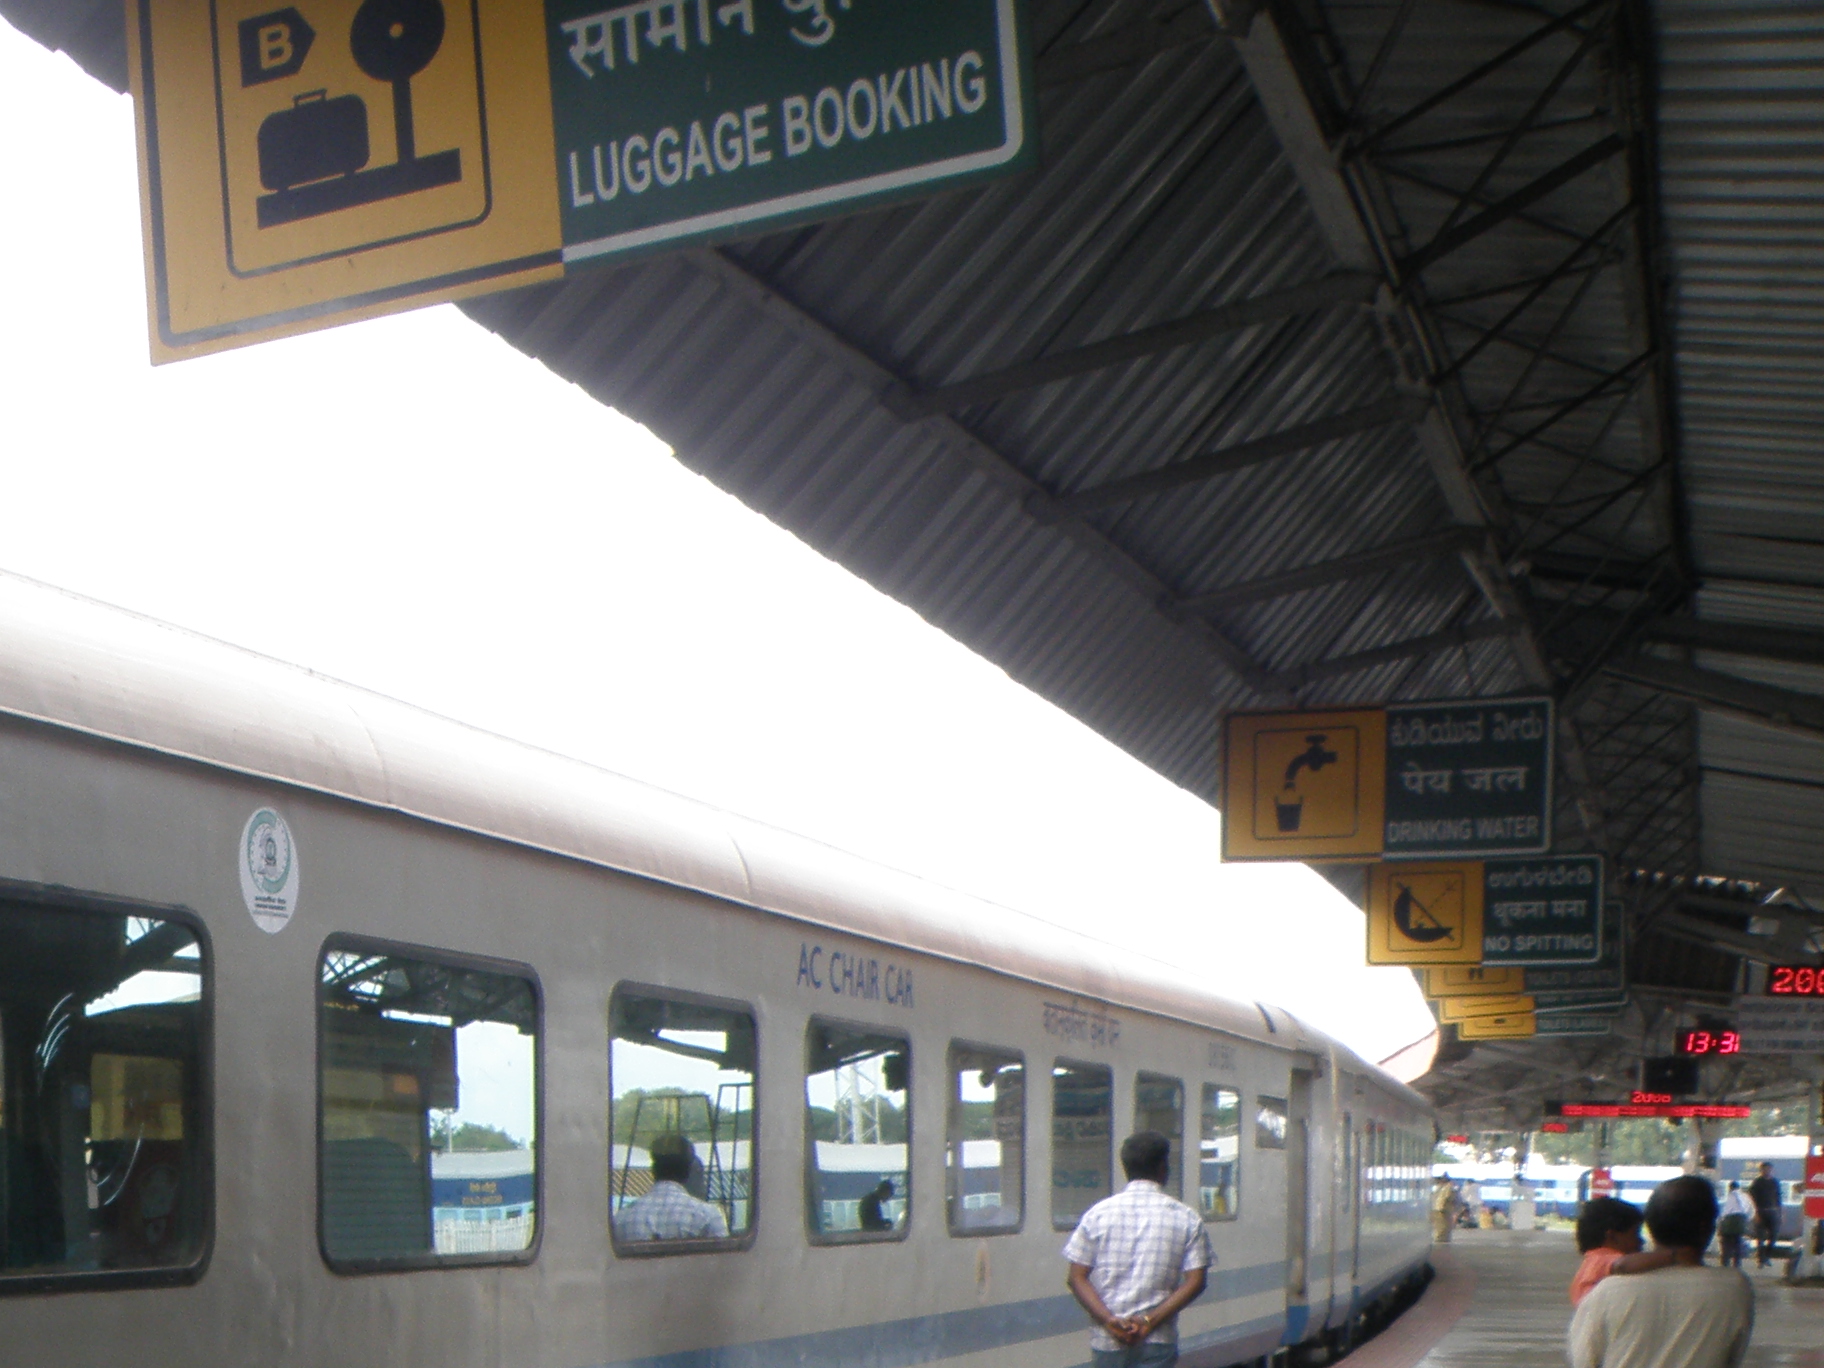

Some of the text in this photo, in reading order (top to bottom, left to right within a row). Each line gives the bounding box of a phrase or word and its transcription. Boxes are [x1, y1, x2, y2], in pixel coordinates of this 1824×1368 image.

[258, 22, 294, 70] B
[569, 49, 987, 208] LUGGAGE BOOKING
[1401, 760, 1529, 795] पेय जल
[1387, 815, 1540, 844] DRINKING WATER
[1484, 935, 1511, 952] NO
[1514, 933, 1594, 951] SPITTING
[796, 941, 914, 1009] AC CHAIR CAR
